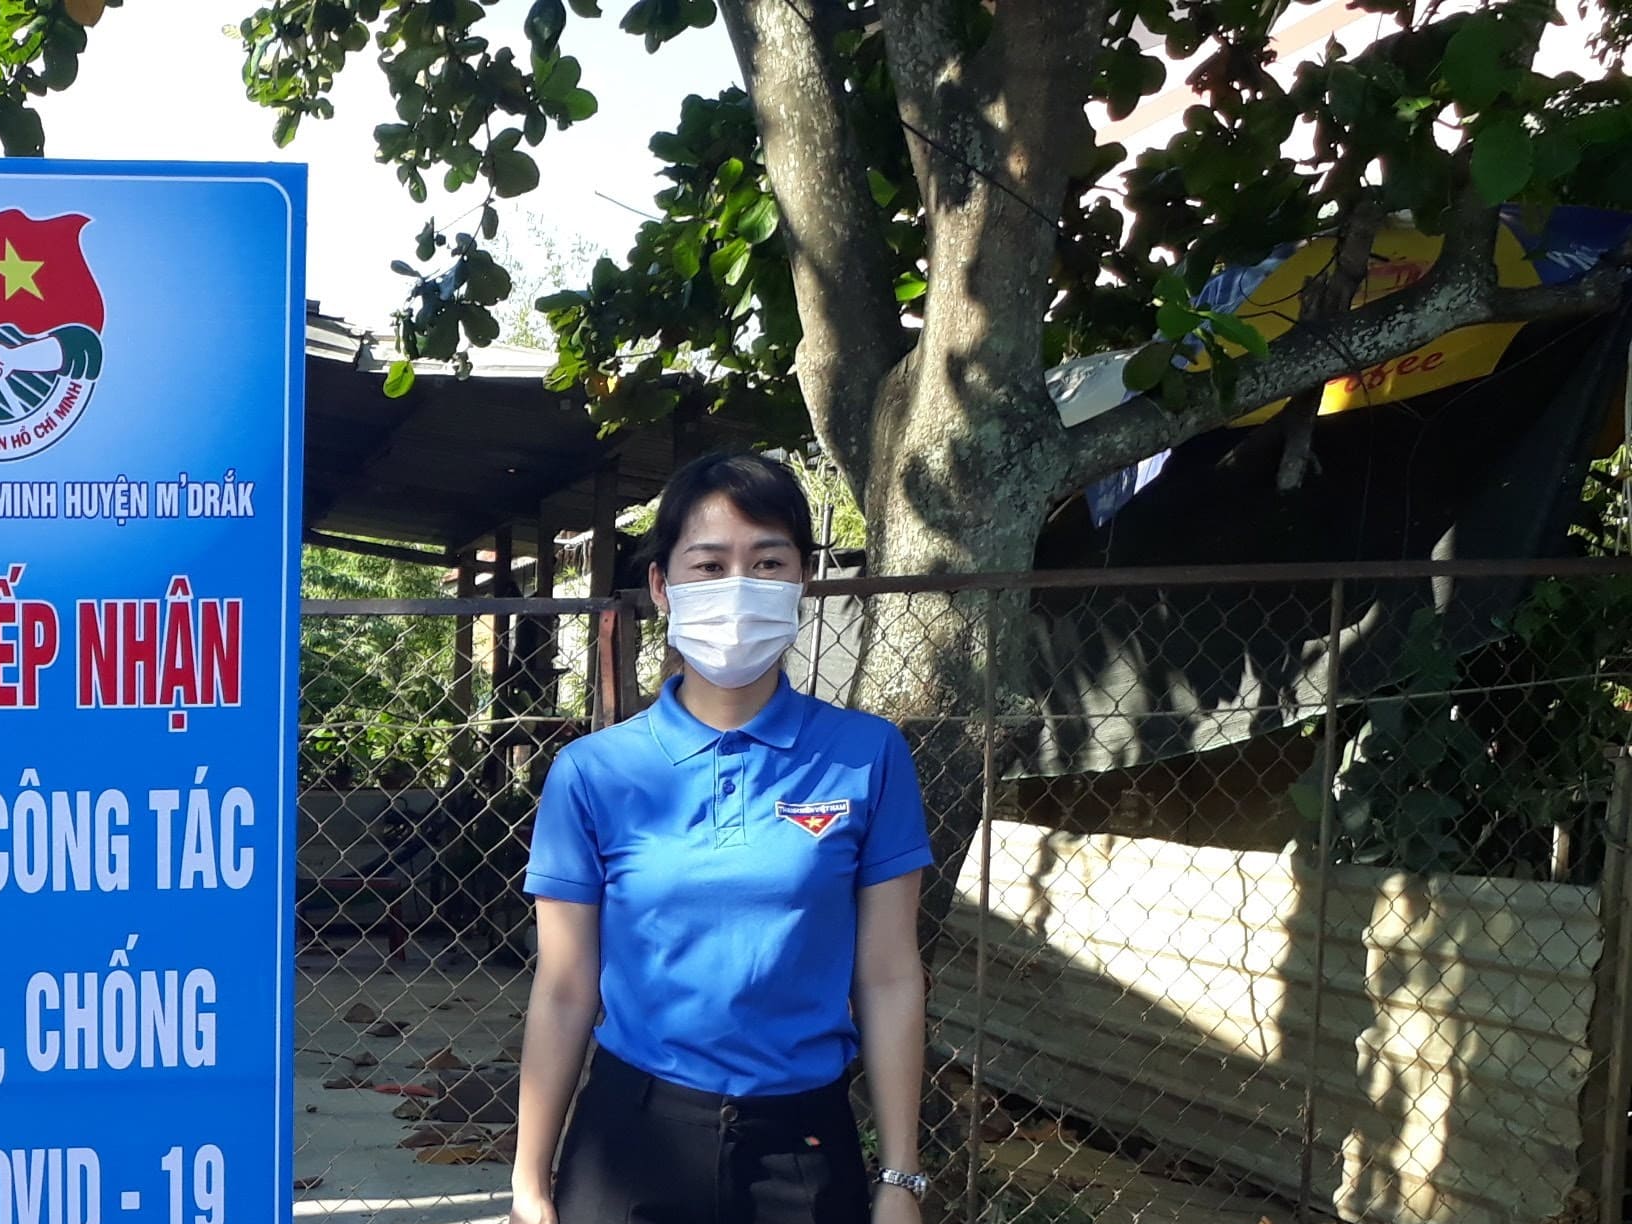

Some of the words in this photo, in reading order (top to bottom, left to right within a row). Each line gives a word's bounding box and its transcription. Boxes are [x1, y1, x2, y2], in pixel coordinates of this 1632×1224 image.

[11, 425, 32, 449] HỒ
[33, 411, 58, 439] CHÍ
[54, 382, 82, 421] MINH
[65, 475, 147, 526] HUYỆN
[76, 575, 243, 733] NHẬN
[149, 766, 256, 891] TÁC
[26, 934, 217, 1072] CHỐNG
